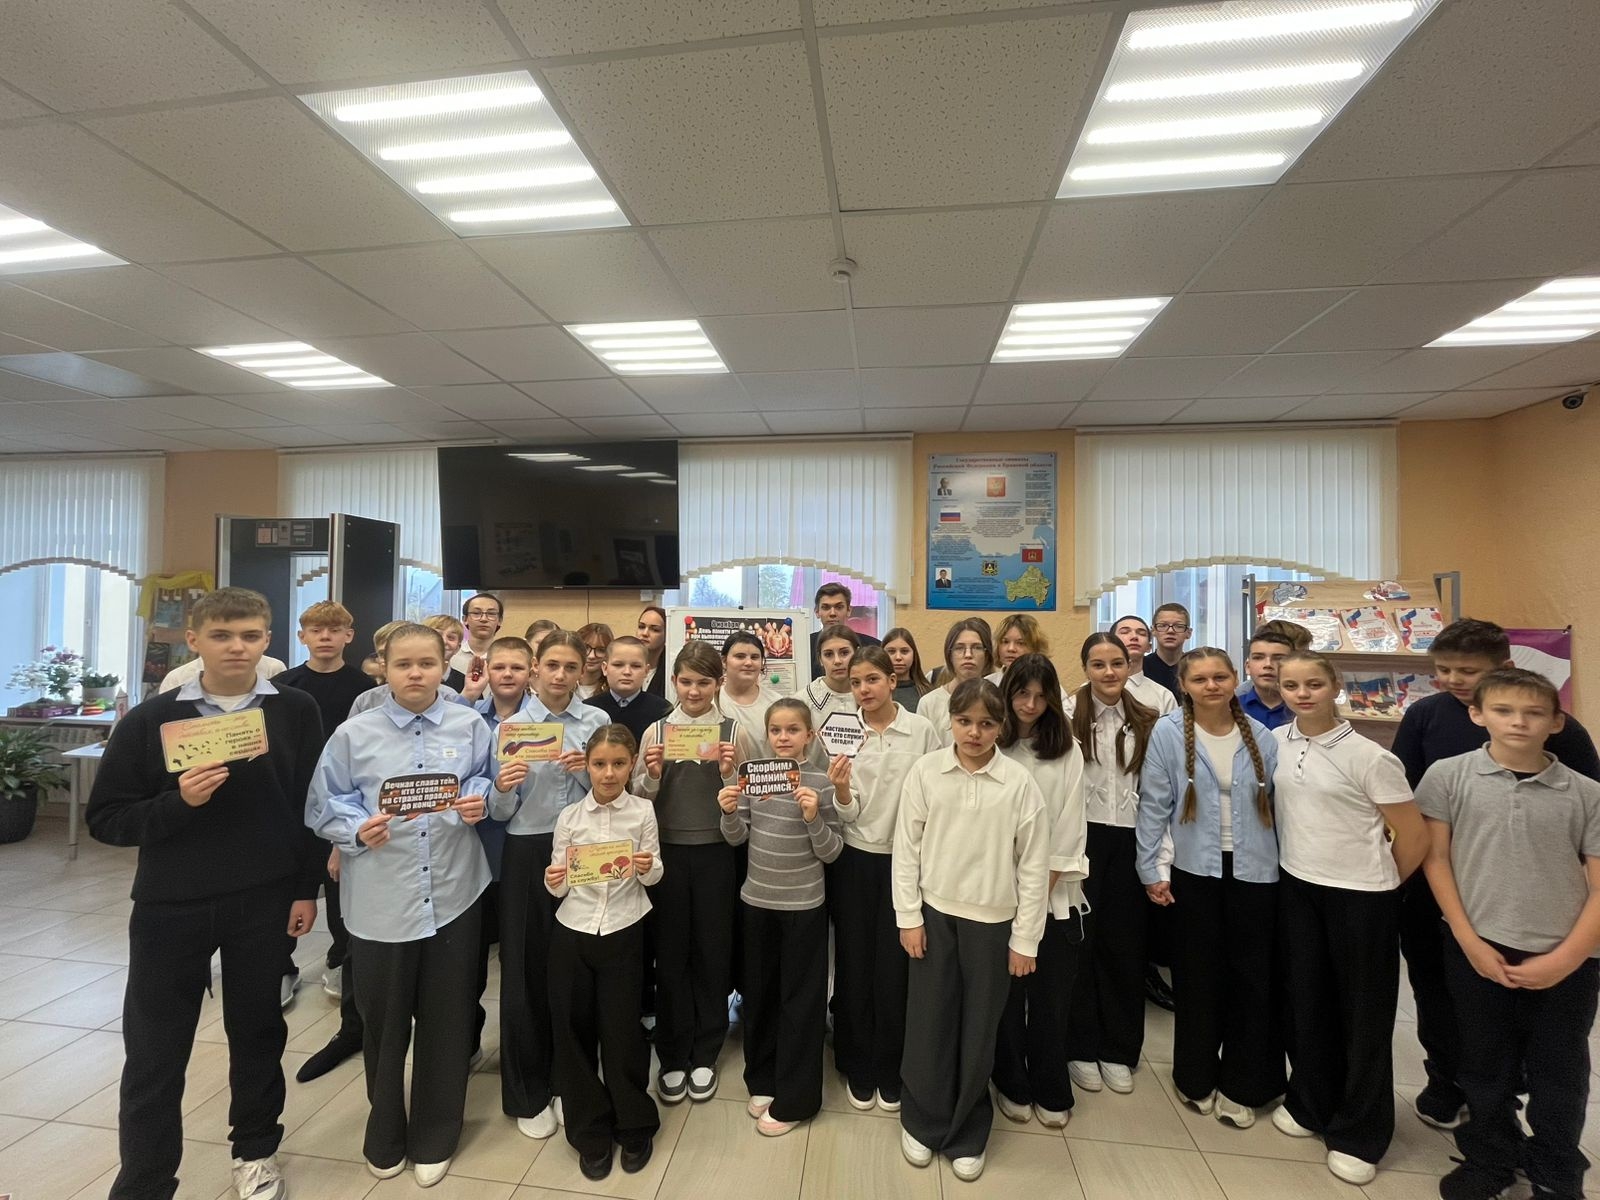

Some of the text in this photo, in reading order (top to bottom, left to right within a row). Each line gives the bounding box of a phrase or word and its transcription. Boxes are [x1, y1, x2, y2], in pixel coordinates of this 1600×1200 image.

[226, 730, 254, 739] Память
[747, 761, 791, 774] Скорбим.
[749, 772, 789, 784] Помним.
[384, 780, 415, 790] Вечная
[415, 779, 439, 787] слава
[745, 783, 794, 795] Гордимся.
[401, 786, 439, 796] кто стоял
[381, 792, 455, 805] на страже правды
[400, 801, 437, 812] до конца
